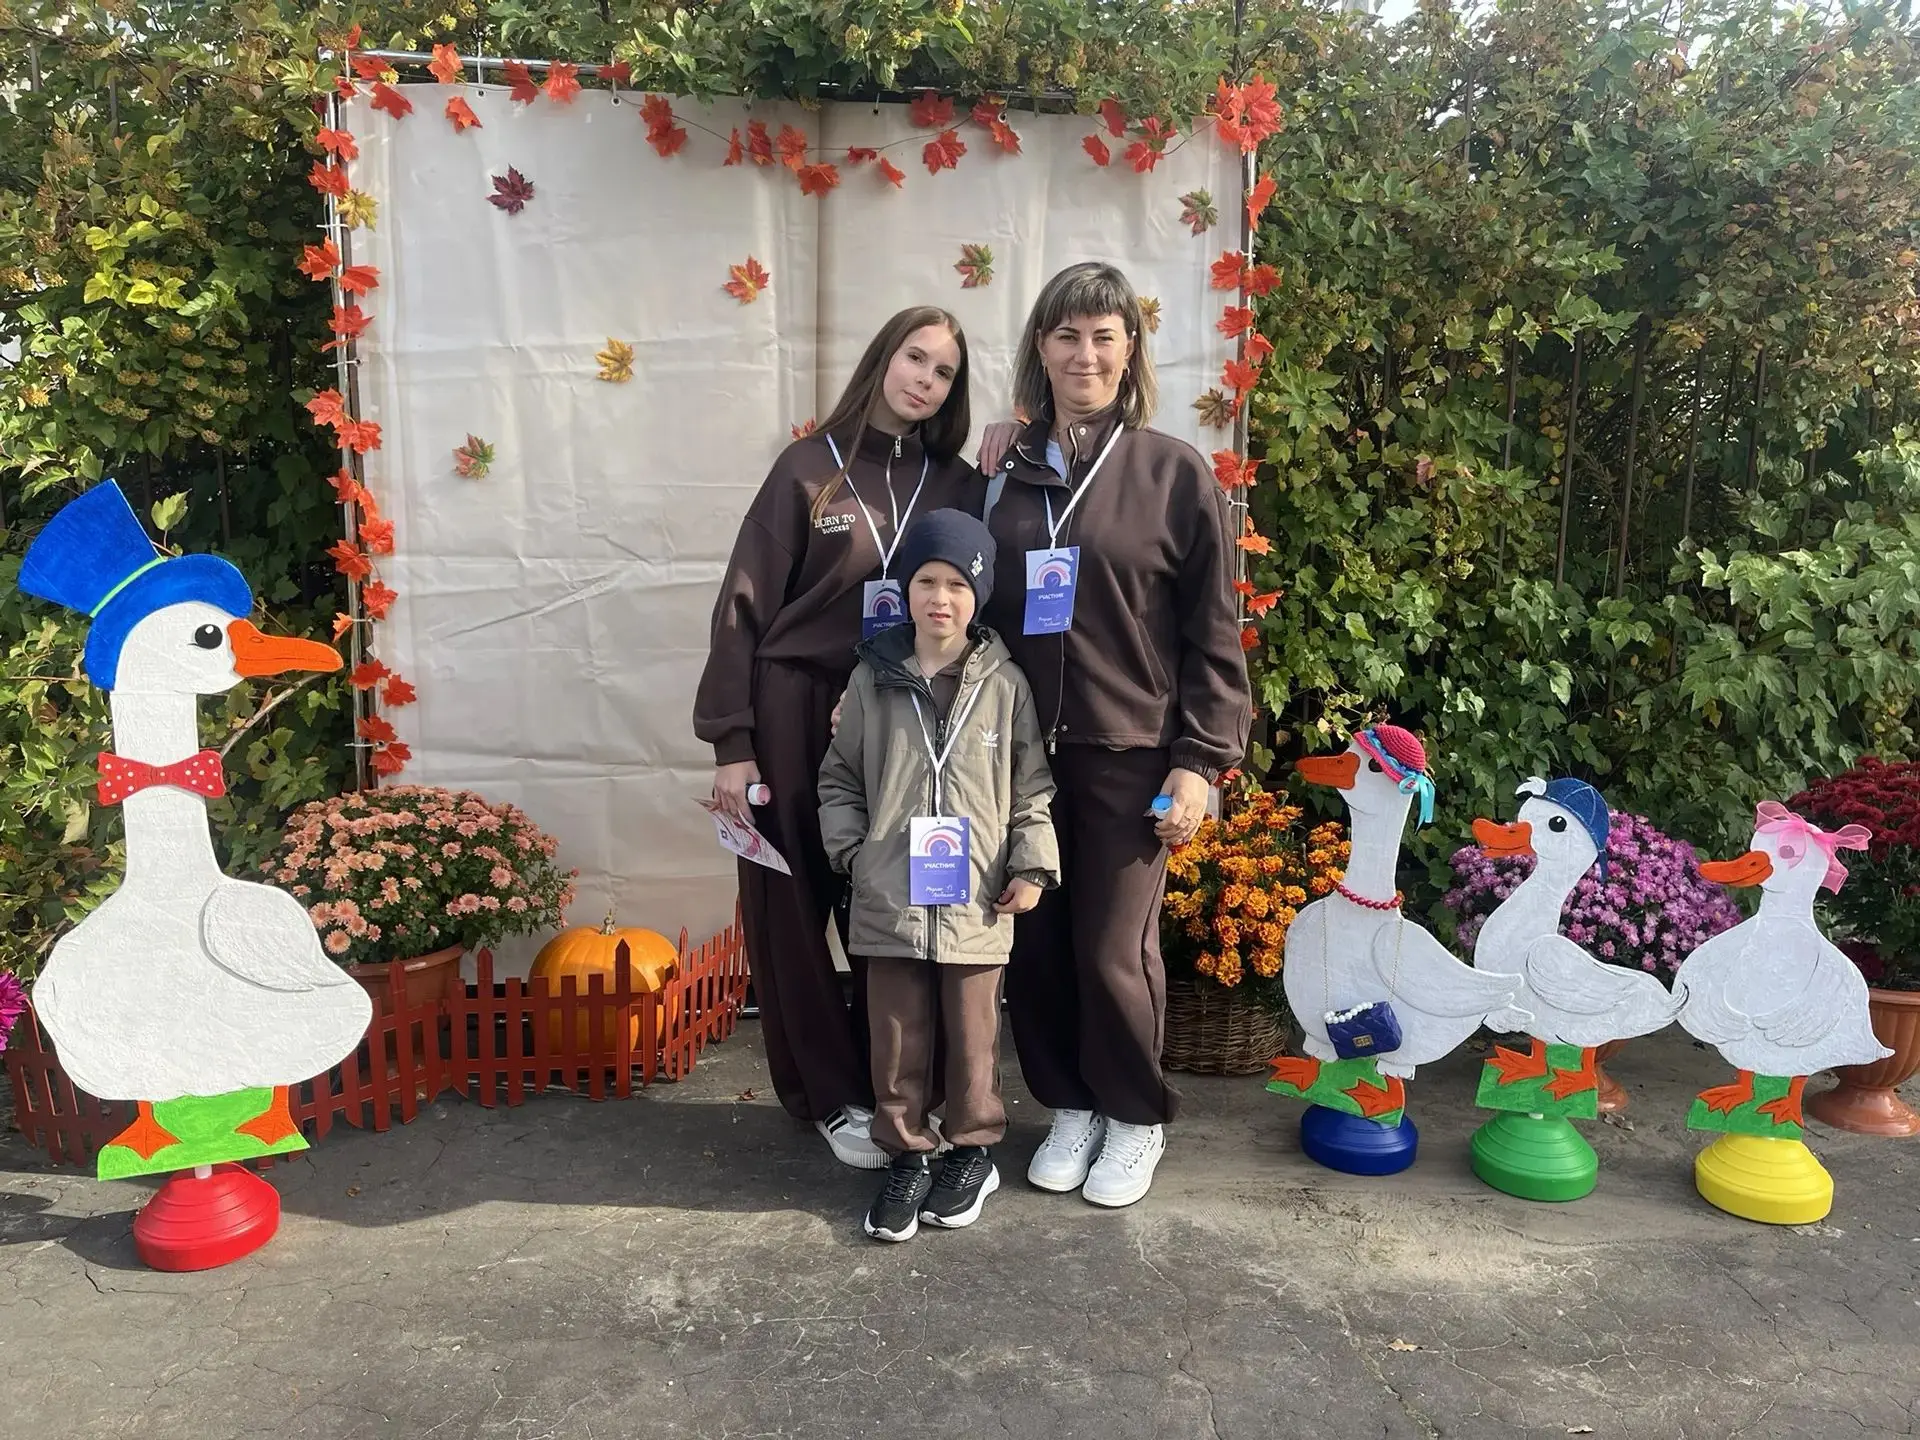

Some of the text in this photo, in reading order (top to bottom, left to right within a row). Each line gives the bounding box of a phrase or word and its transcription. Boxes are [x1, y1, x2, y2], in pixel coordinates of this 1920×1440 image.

[842, 514, 856, 523] TO
[822, 524, 850, 534] SUCCESS
[1064, 617, 1070, 627] 3
[960, 889, 967, 899] 3
